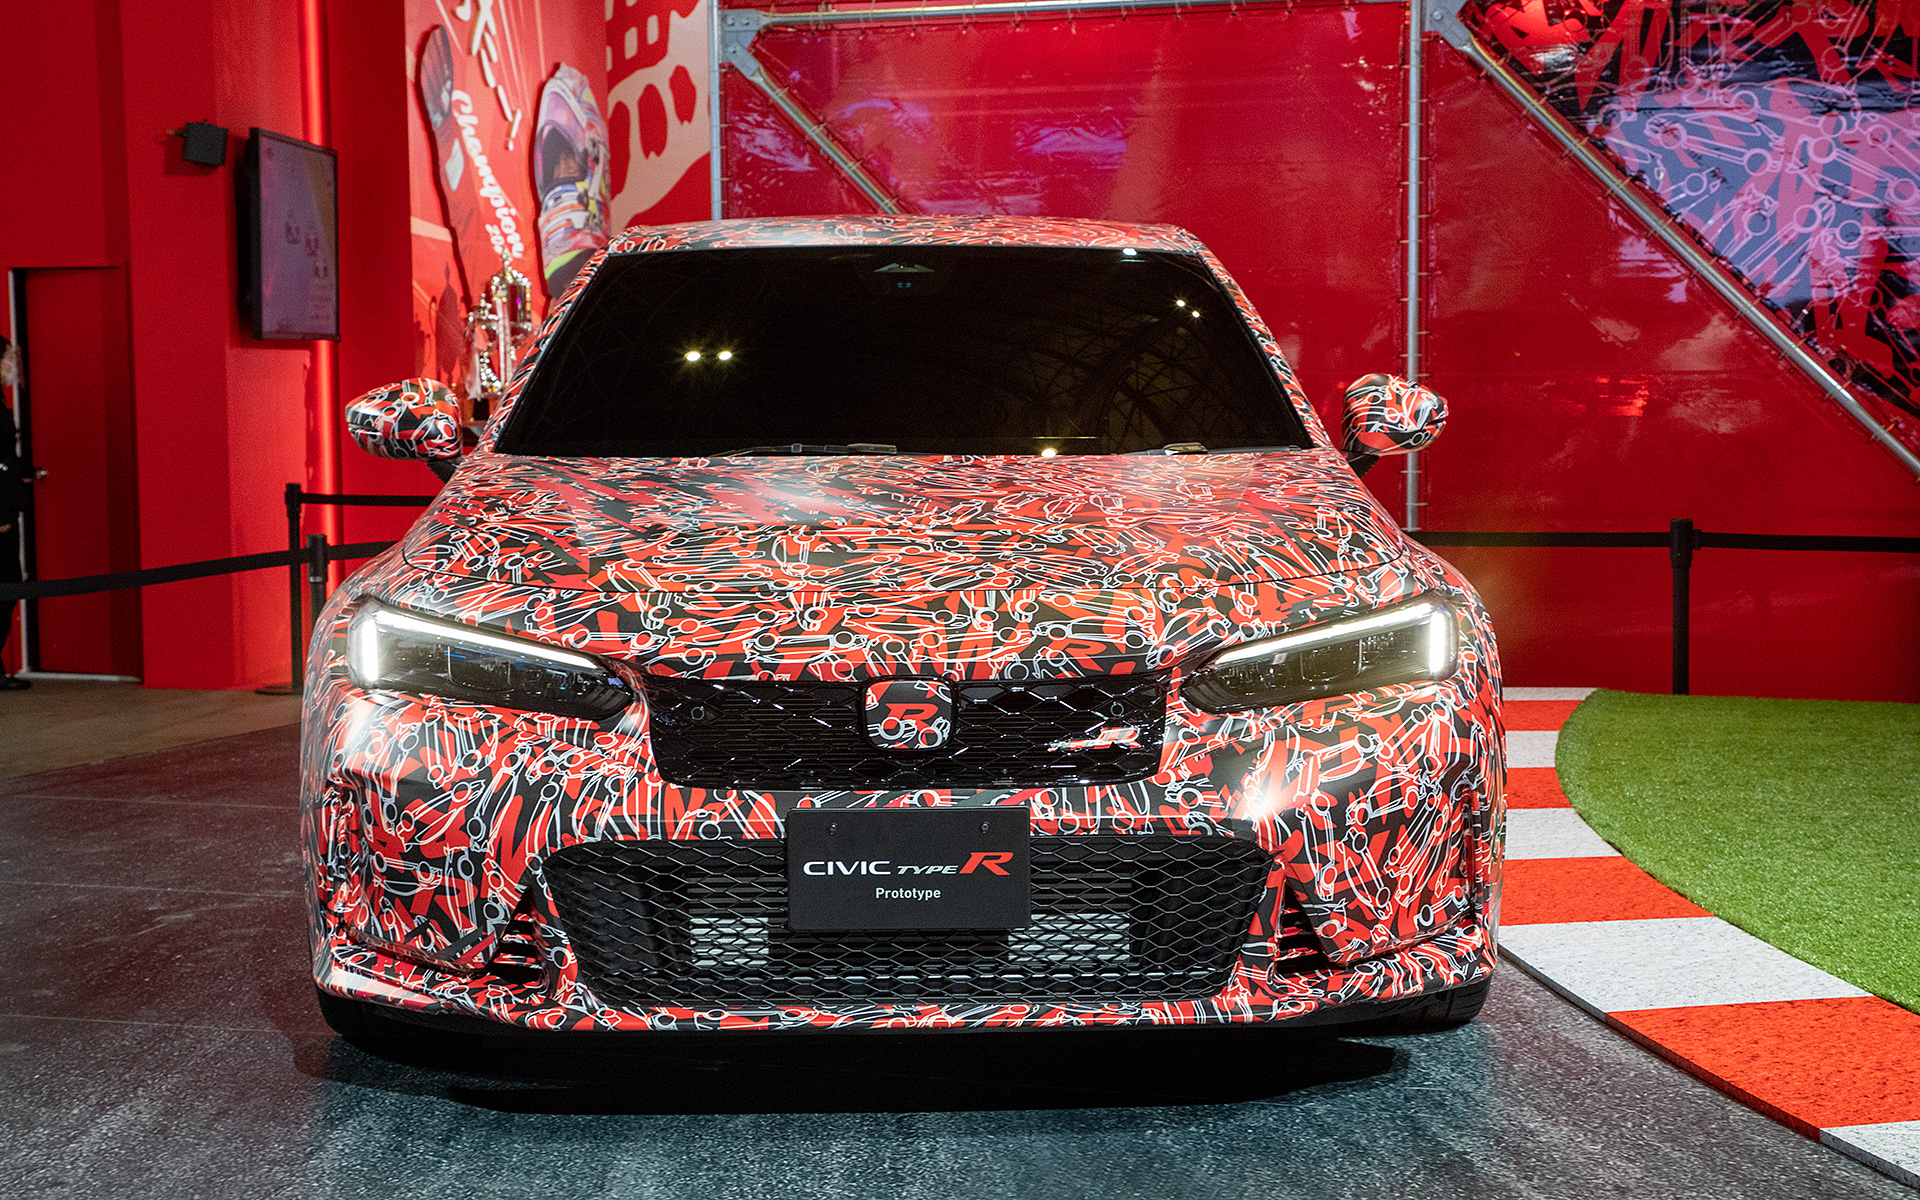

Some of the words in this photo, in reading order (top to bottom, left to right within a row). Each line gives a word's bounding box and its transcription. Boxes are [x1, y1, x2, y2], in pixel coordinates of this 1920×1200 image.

[451, 89, 524, 258] Champion
[803, 860, 891, 876] CIVIC
[897, 865, 959, 875] TYPE
[959, 851, 1014, 876] R
[875, 887, 941, 900] Prototype
